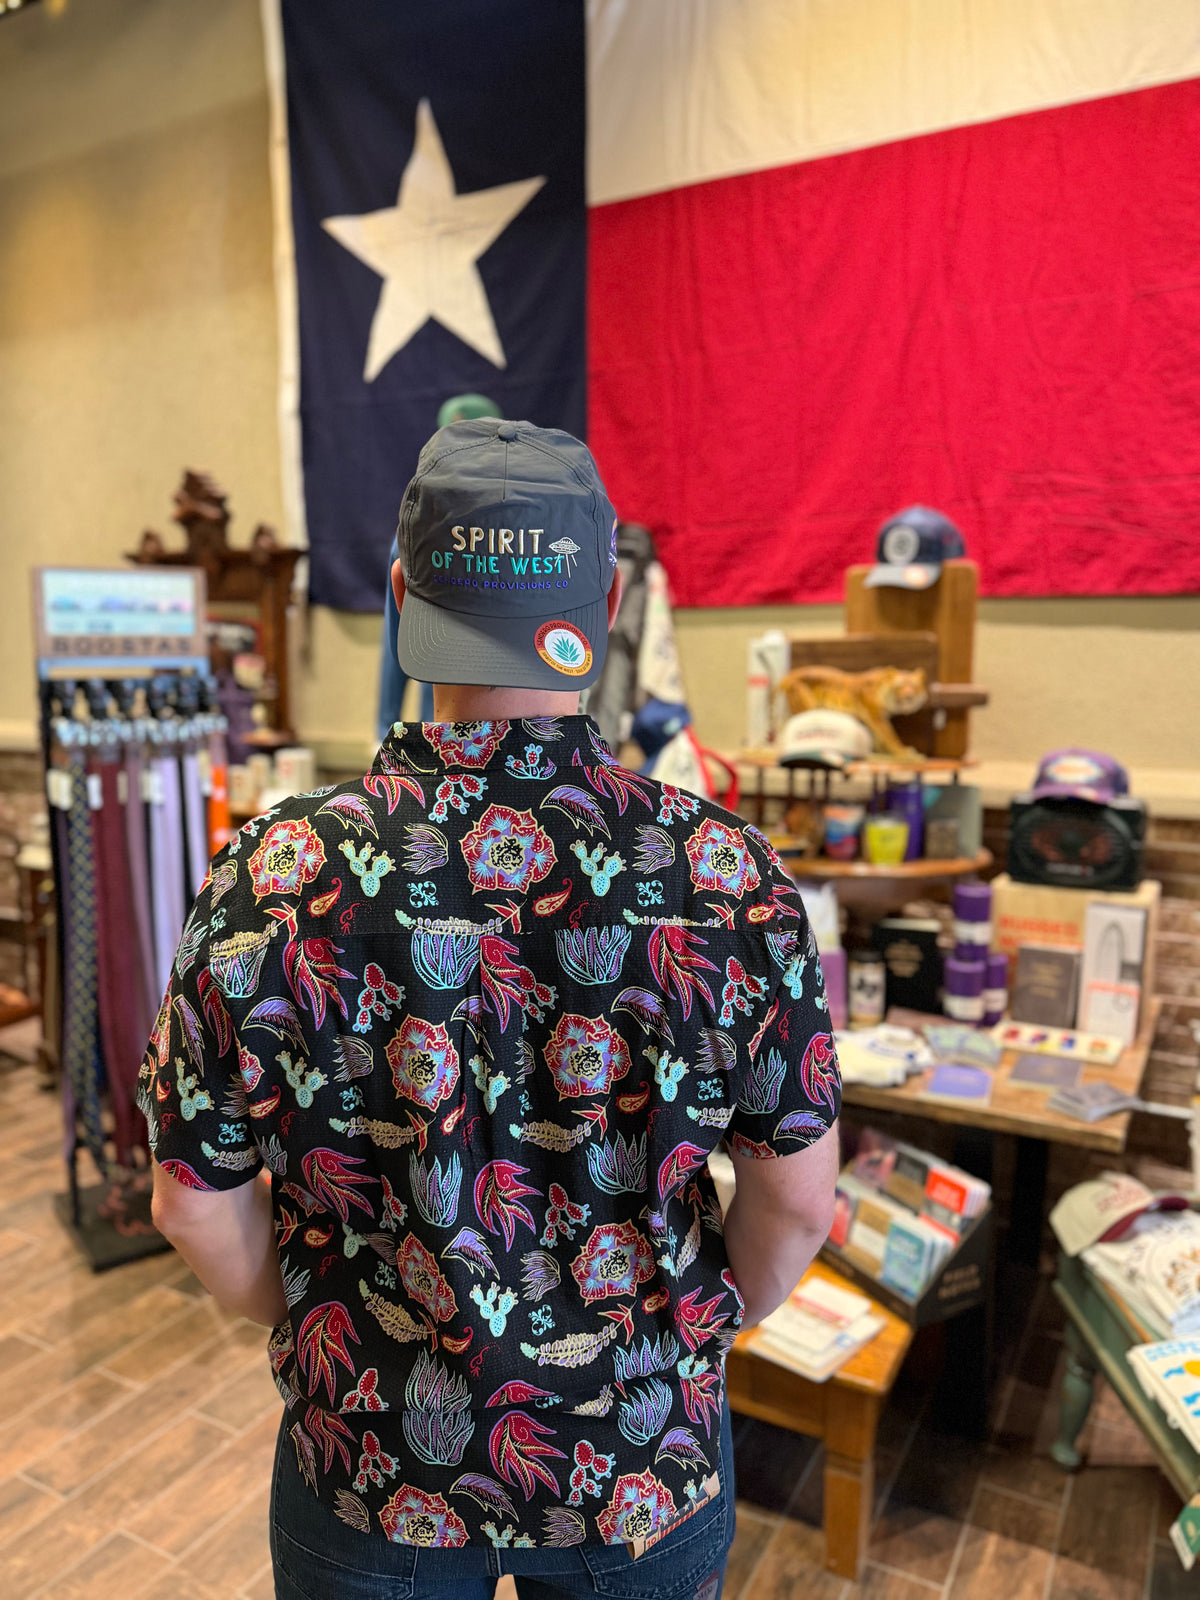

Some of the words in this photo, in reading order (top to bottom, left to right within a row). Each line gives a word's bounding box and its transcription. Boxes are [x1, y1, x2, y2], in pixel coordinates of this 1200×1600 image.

[451, 525, 544, 554] SPIRIT
[431, 551, 454, 569] OF
[461, 554, 500, 574] THE
[510, 555, 565, 575] WEST
[484, 580, 551, 590] PROVISIONS
[555, 580, 568, 588] CO
